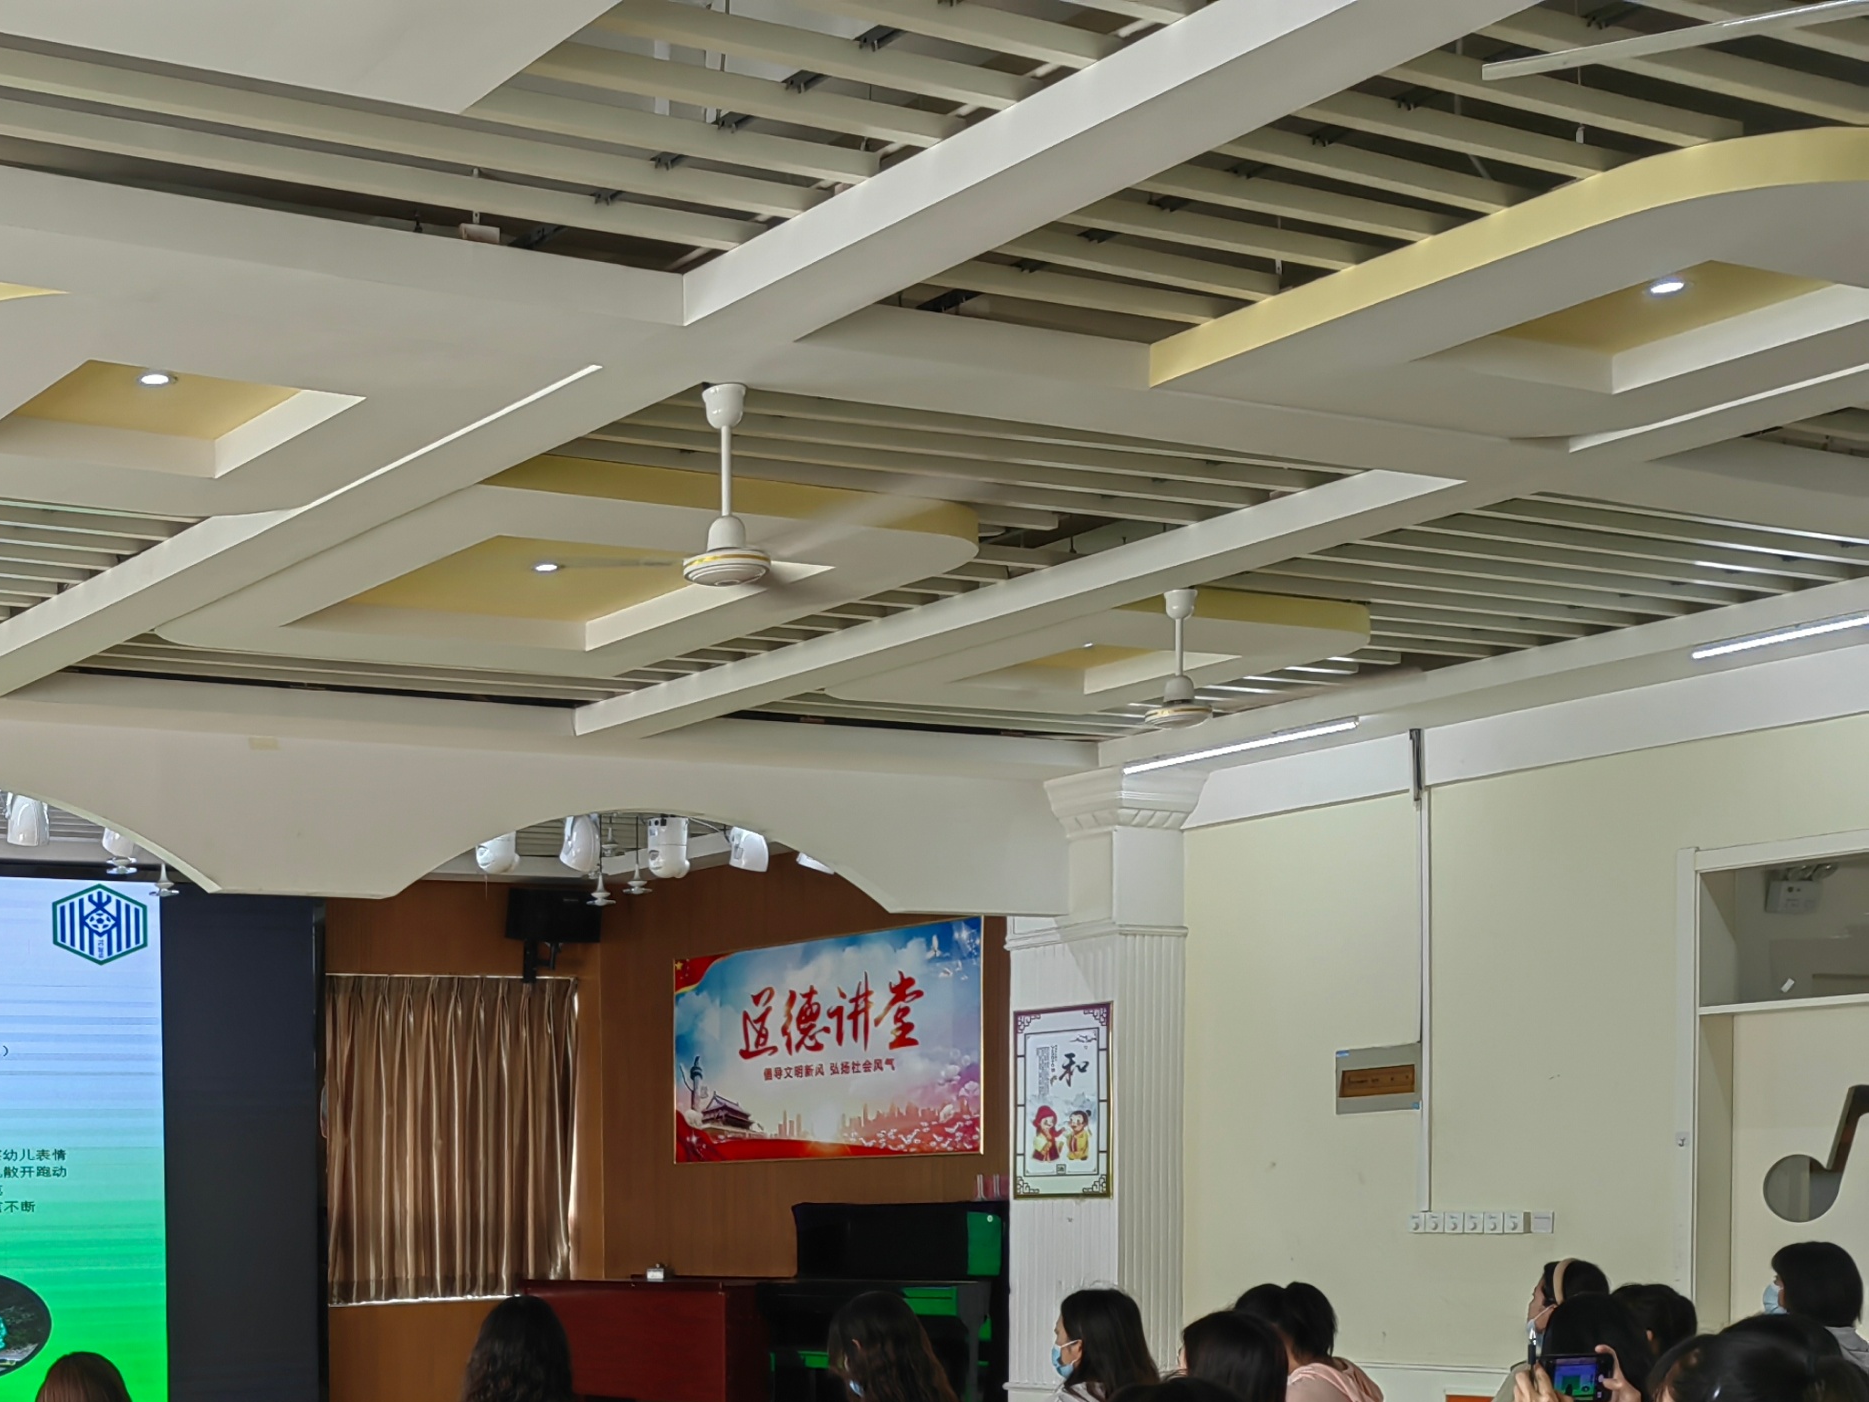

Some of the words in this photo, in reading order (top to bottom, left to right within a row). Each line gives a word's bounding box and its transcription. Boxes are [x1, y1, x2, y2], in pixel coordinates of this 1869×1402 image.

[739, 970, 924, 1060] 道德讲堂
[764, 1064, 825, 1081] 倡导文明新风
[830, 1058, 896, 1076] 弘扬社会风气
[1059, 1053, 1090, 1087] 和
